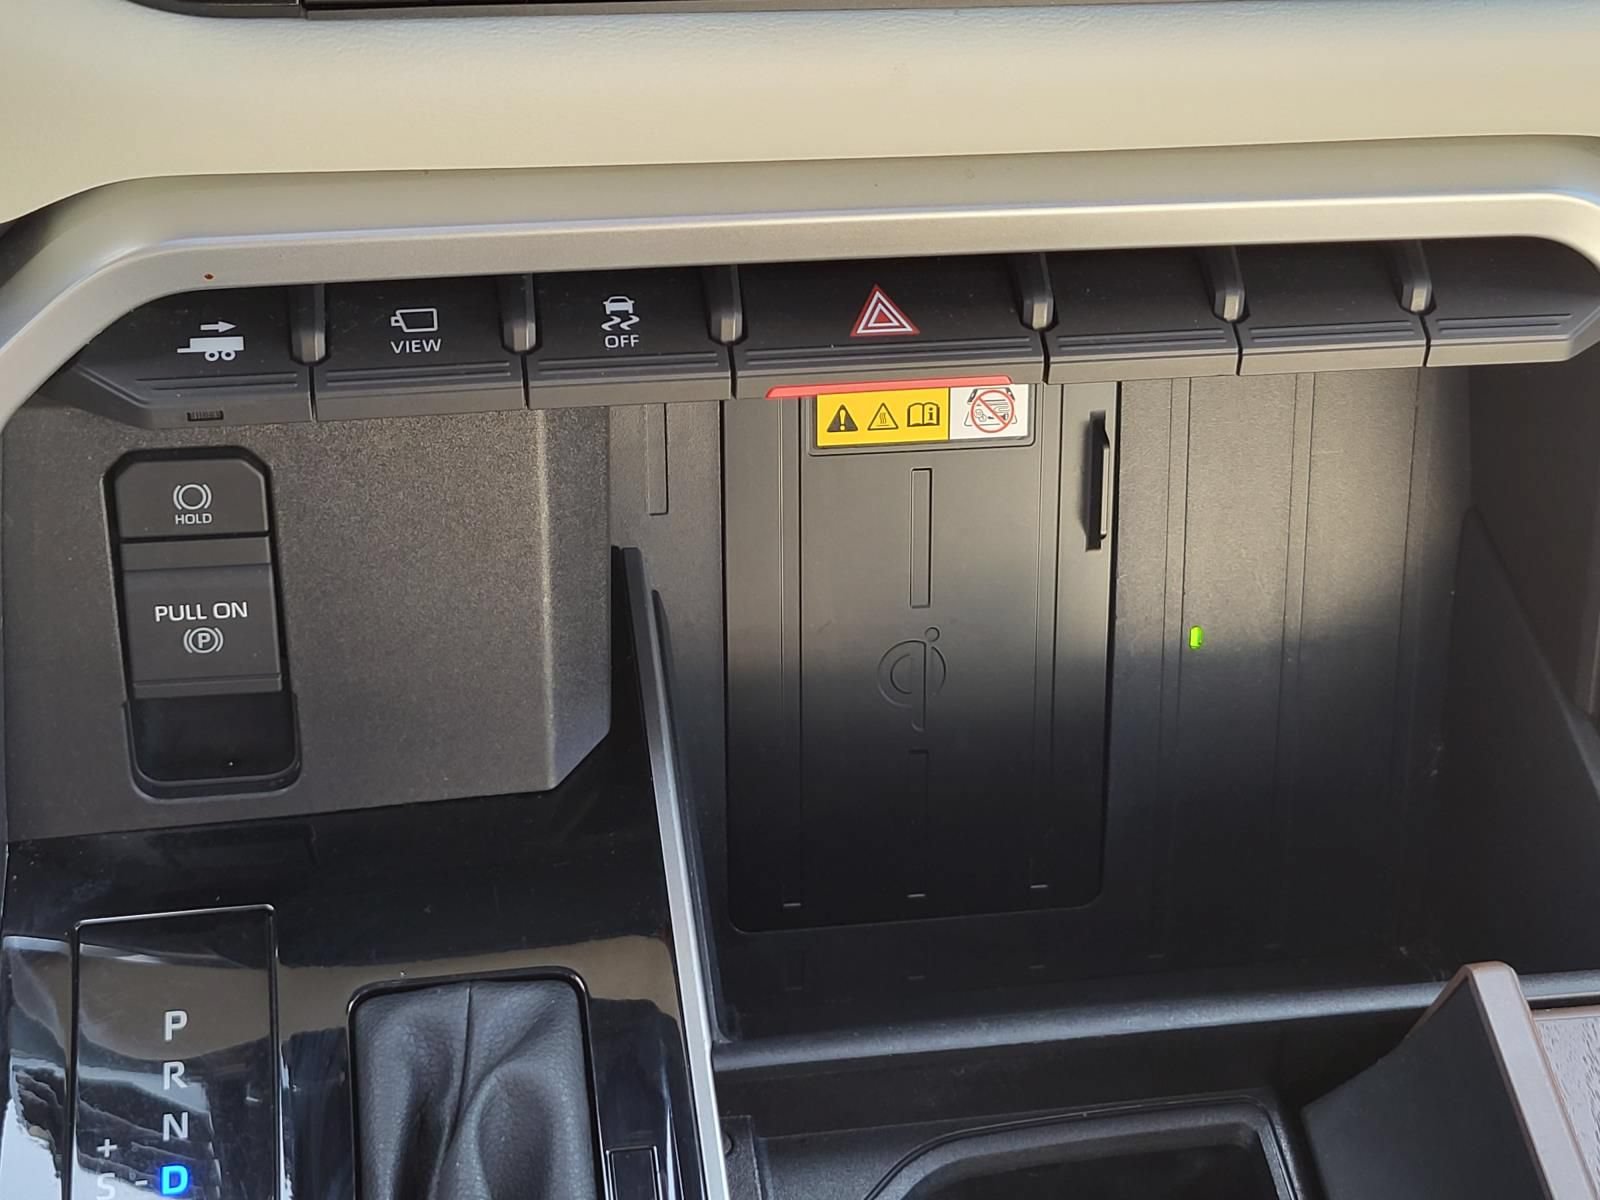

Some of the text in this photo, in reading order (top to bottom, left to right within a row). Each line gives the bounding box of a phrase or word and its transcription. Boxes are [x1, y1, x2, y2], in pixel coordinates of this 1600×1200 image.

[390, 338, 442, 354] VIEW
[604, 334, 640, 348] OFF
[175, 513, 213, 525] HOLD
[154, 601, 248, 622] PULL ON
[164, 1009, 188, 1041] P
[163, 1061, 189, 1091] R
[162, 1111, 189, 1141] N
[96, 1172, 116, 1200] S
[162, 1165, 188, 1195] D
